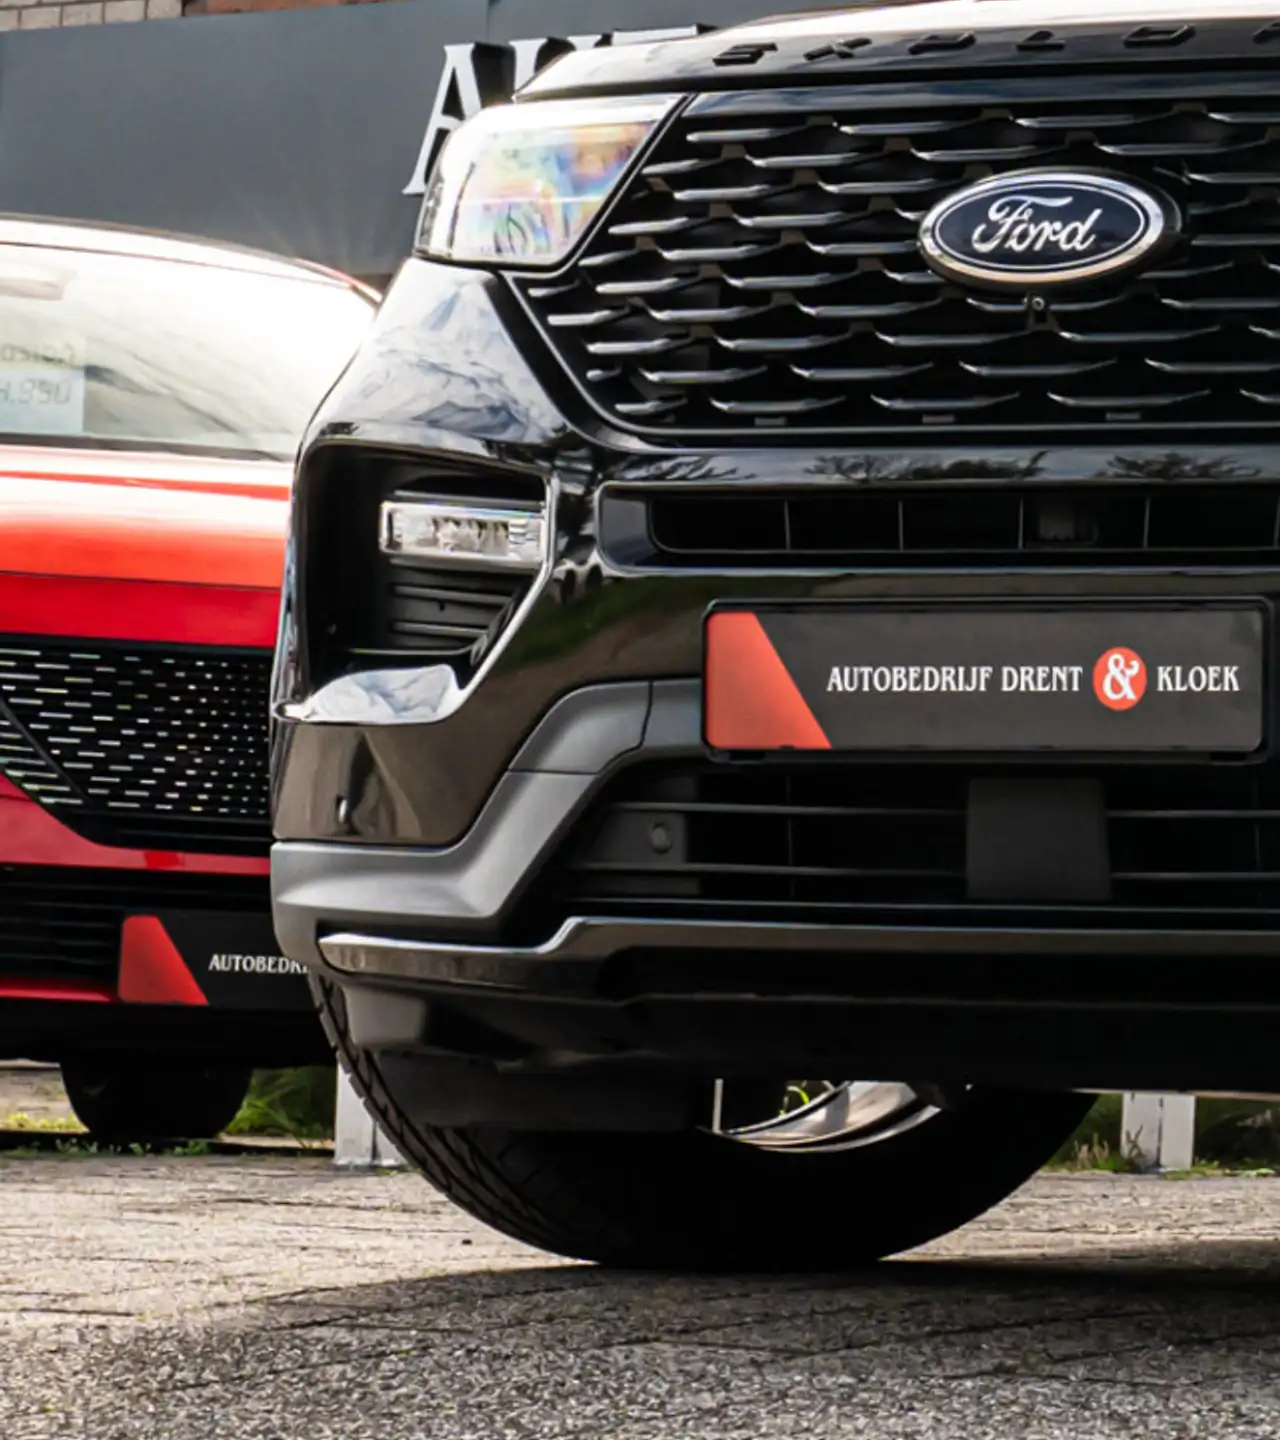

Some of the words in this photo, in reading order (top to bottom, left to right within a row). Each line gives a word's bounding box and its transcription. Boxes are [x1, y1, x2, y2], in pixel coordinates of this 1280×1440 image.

[971, 194, 1103, 254] Ford
[826, 665, 993, 693] AUTOBEDRIJF
[1001, 665, 1084, 693] DRENT
[1102, 652, 1140, 701] &
[1156, 665, 1240, 693] KLOEK
